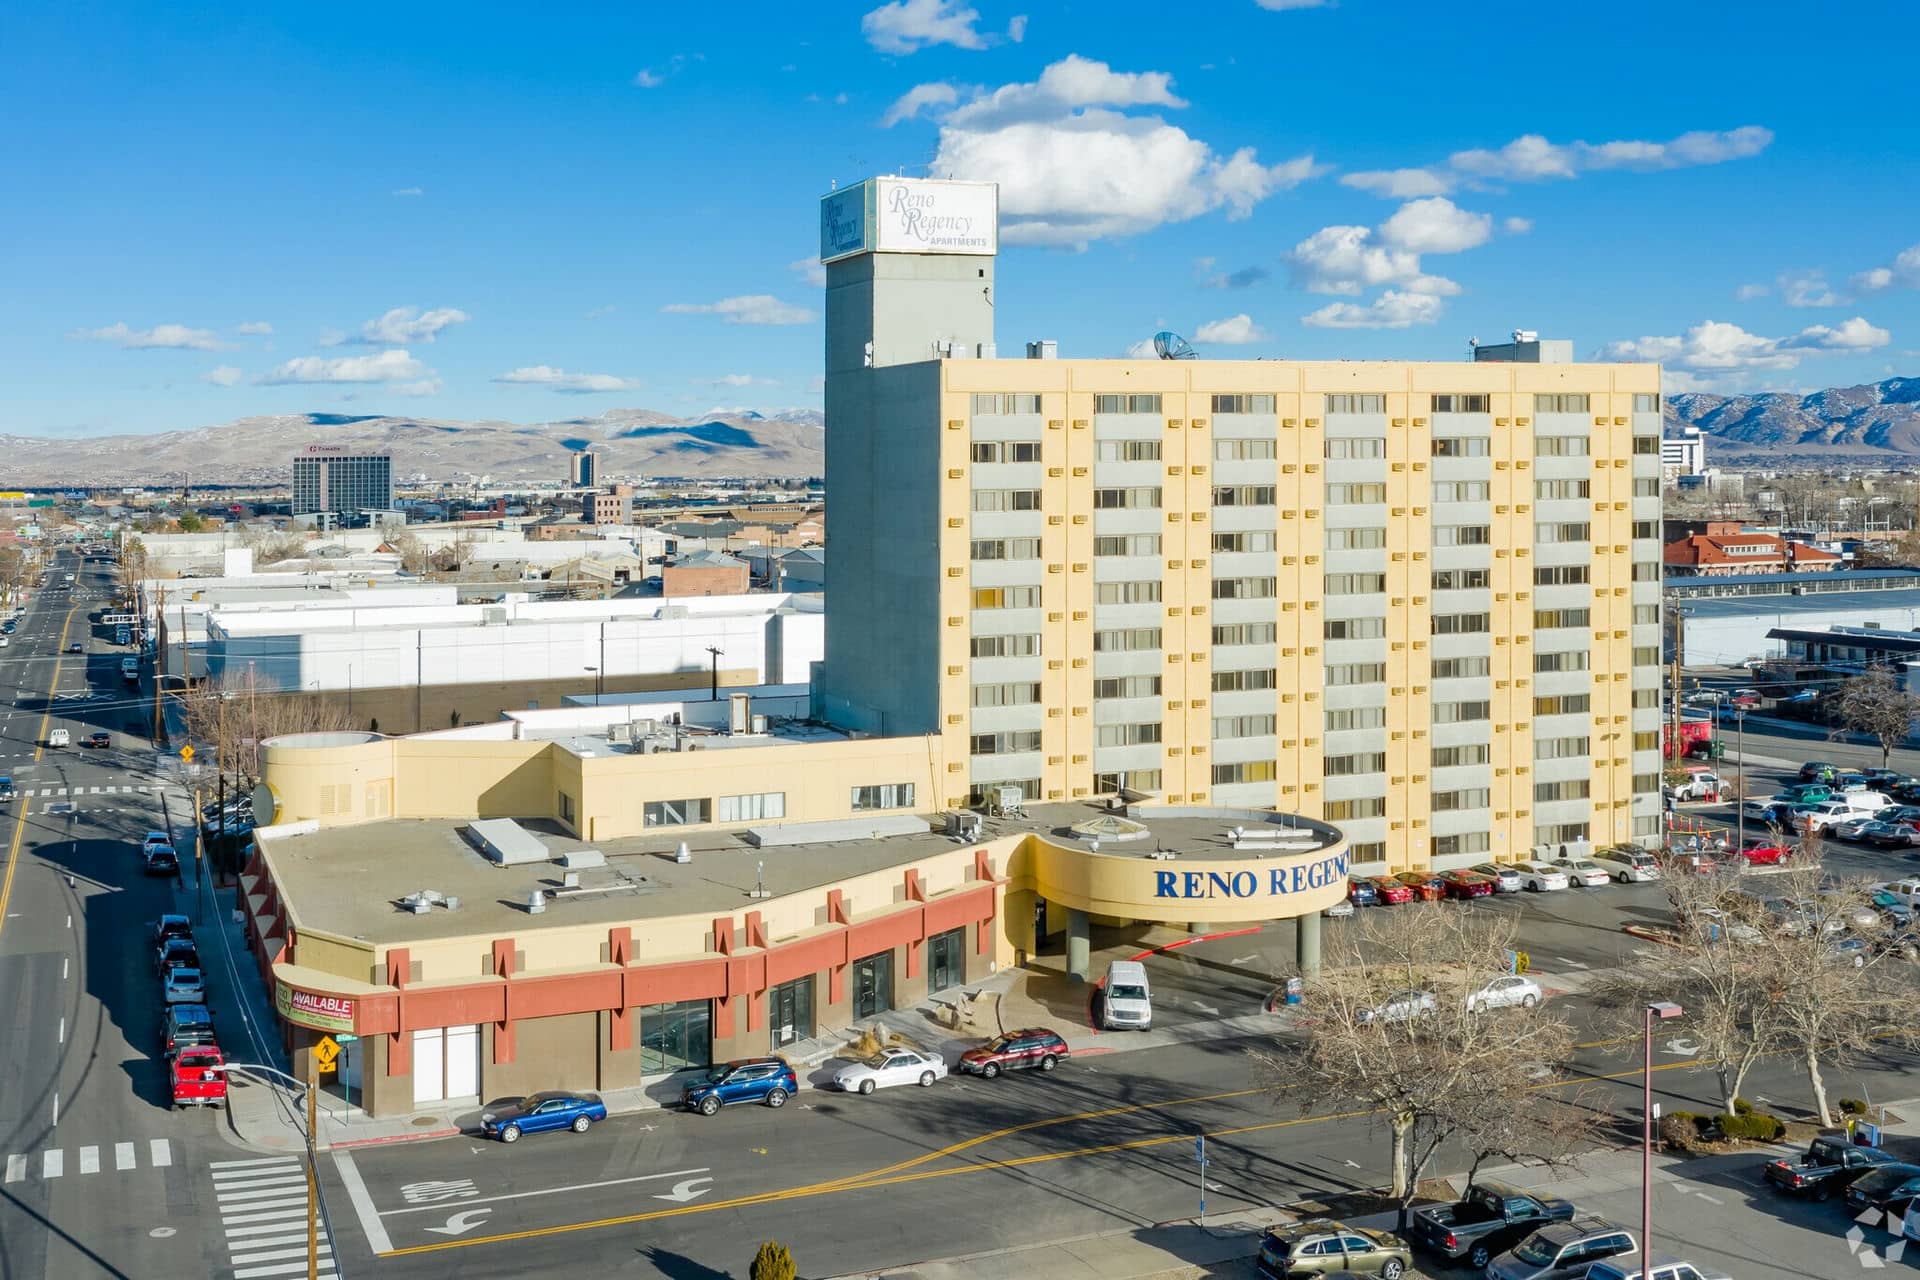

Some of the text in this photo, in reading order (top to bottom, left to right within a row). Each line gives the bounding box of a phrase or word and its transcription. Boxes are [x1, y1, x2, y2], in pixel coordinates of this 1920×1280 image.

[889, 185, 935, 213] Reno
[901, 207, 973, 242] Regency
[930, 237, 987, 247] APARTMENTS
[1153, 847, 1350, 899] RENO REGENC
[293, 991, 351, 1012] AVAILABLE
